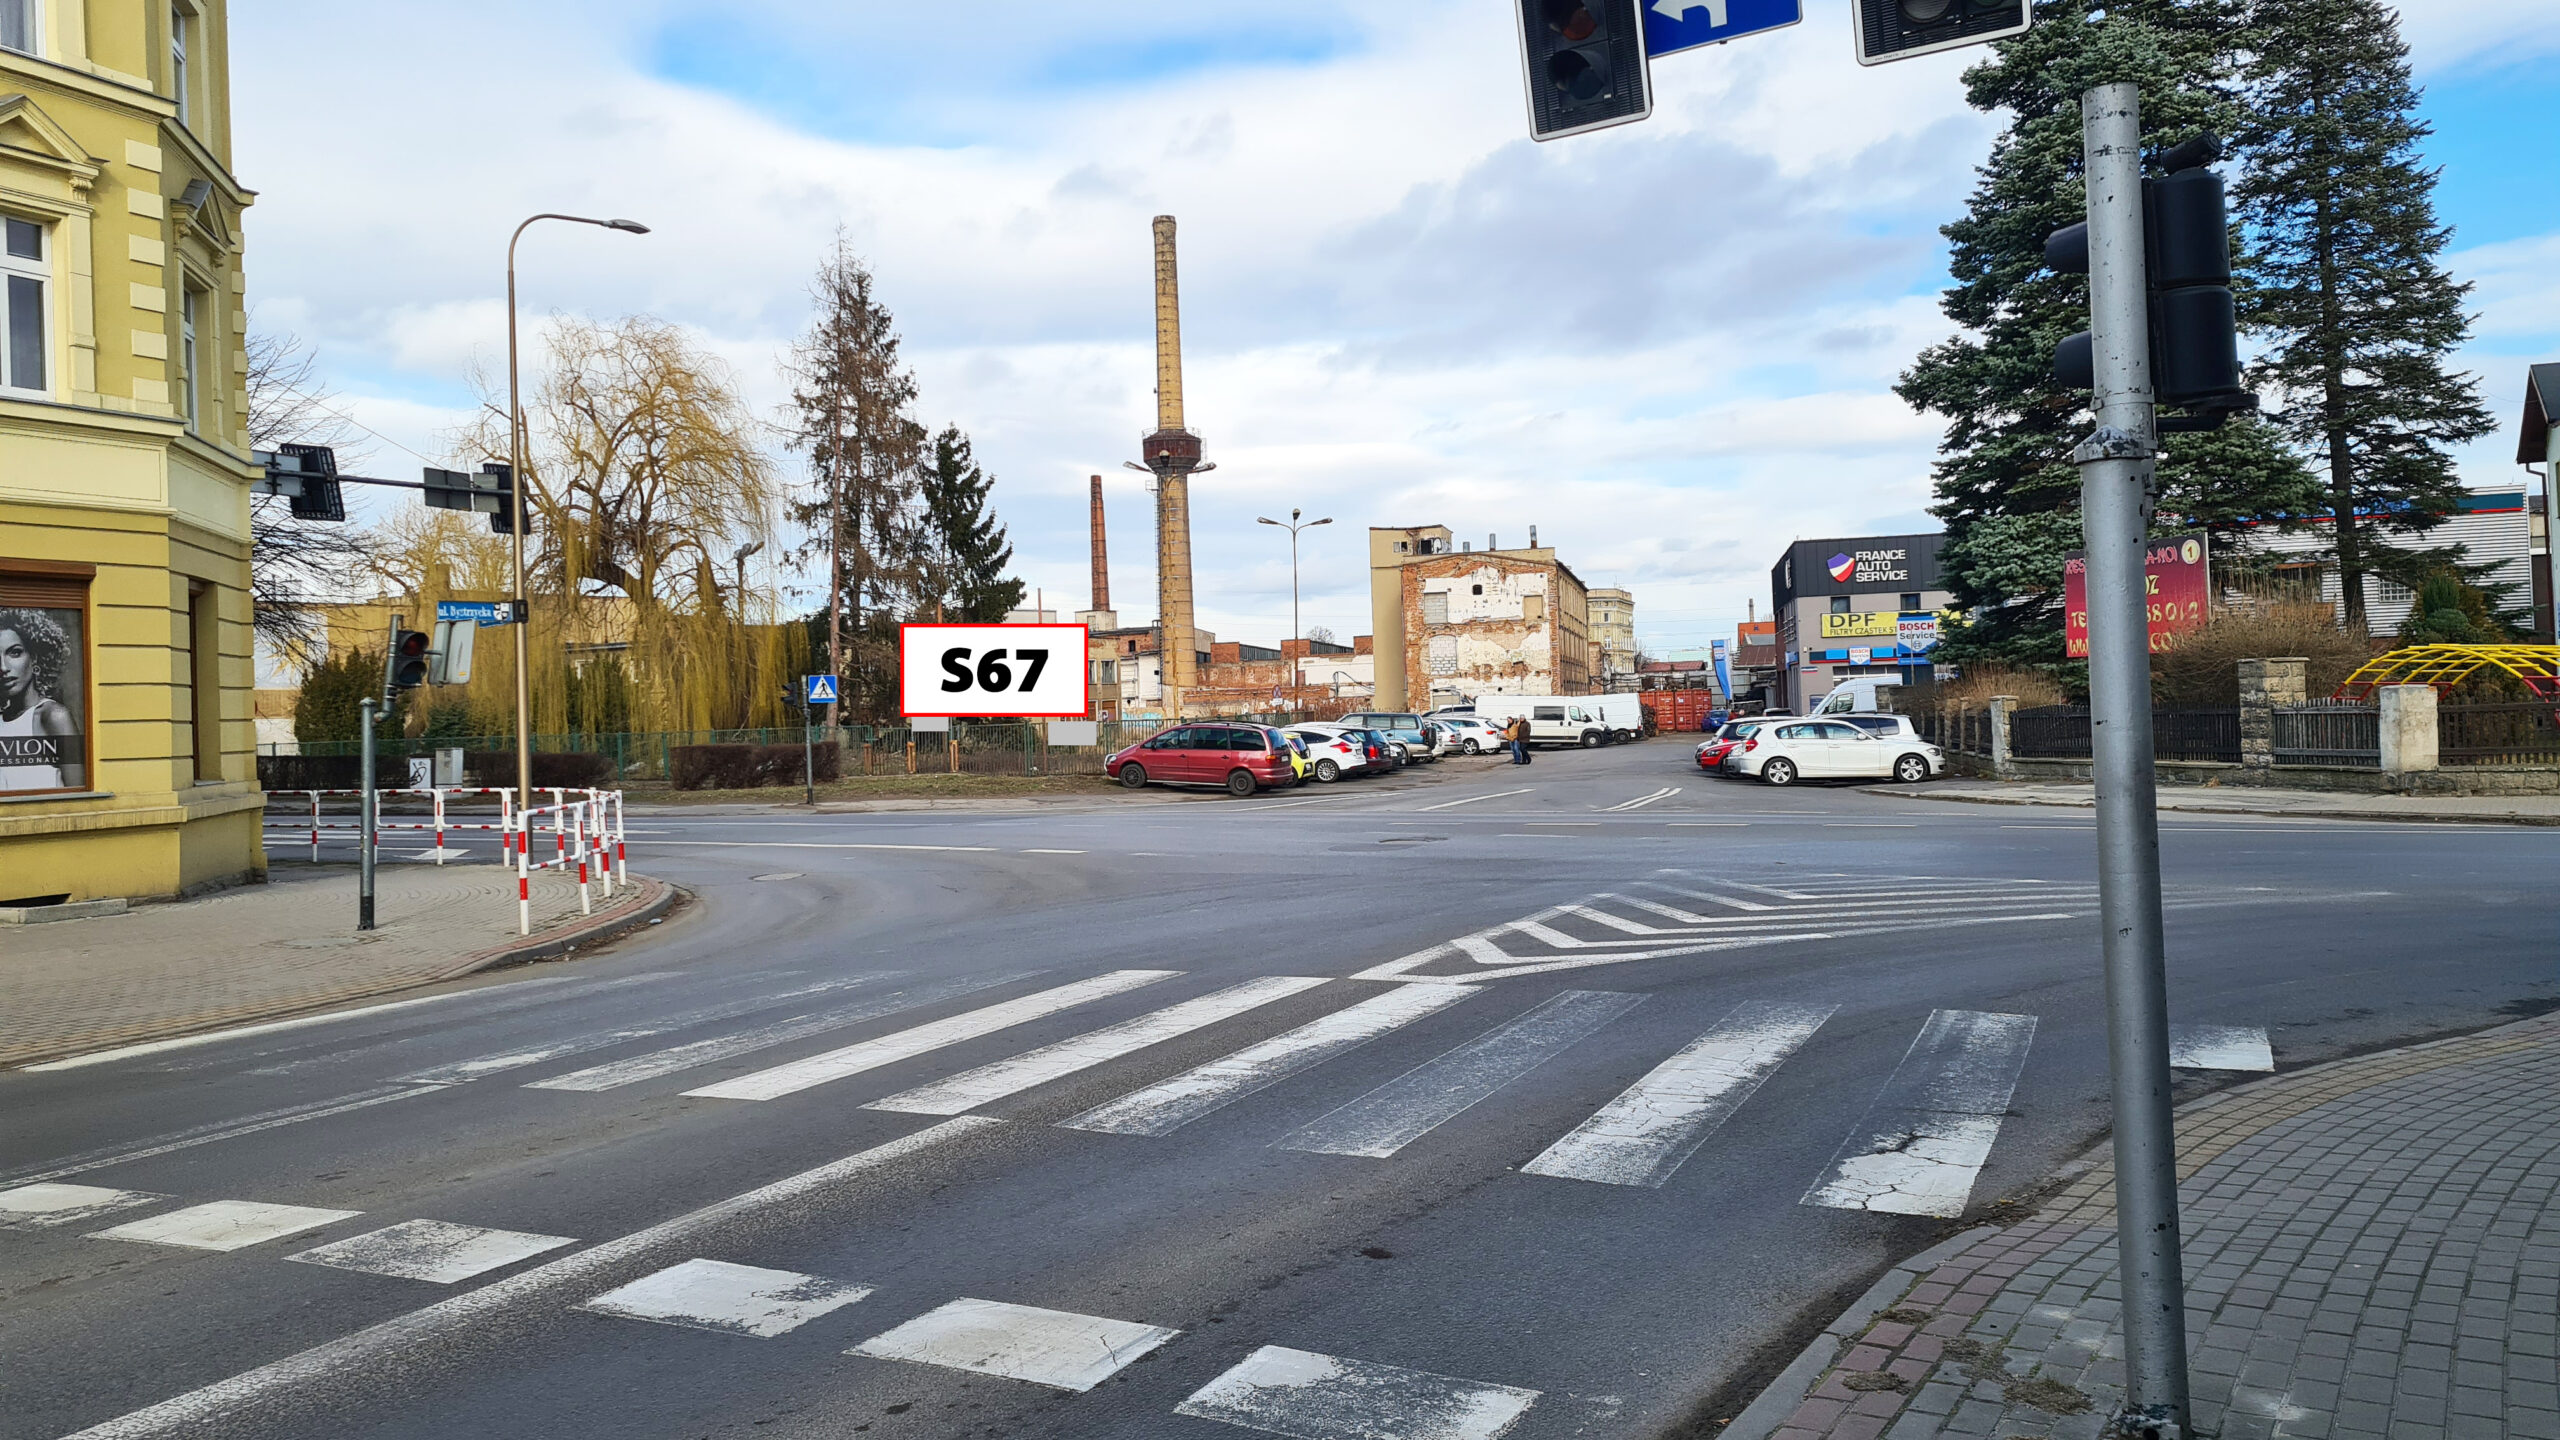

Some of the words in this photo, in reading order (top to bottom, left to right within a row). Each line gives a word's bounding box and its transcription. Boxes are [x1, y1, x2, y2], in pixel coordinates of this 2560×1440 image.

[1855, 549, 1906, 561] FRANCE
[2187, 546, 2193, 558] 1
[1856, 560, 1891, 572] AUTO
[2065, 558, 2085, 575] RES
[1856, 570, 1908, 582] SERVICE
[2146, 574, 2160, 595] Z
[438, 605, 449, 616] ul.
[1830, 613, 1876, 628] DPF
[2071, 611, 2087, 629] TE
[1830, 627, 1853, 635] FILTRY
[1899, 622, 1934, 631] BOSCH
[1900, 632, 1935, 640] Service
[0, 738, 57, 756] VLON
[0, 756, 58, 765] ESSIONAL
